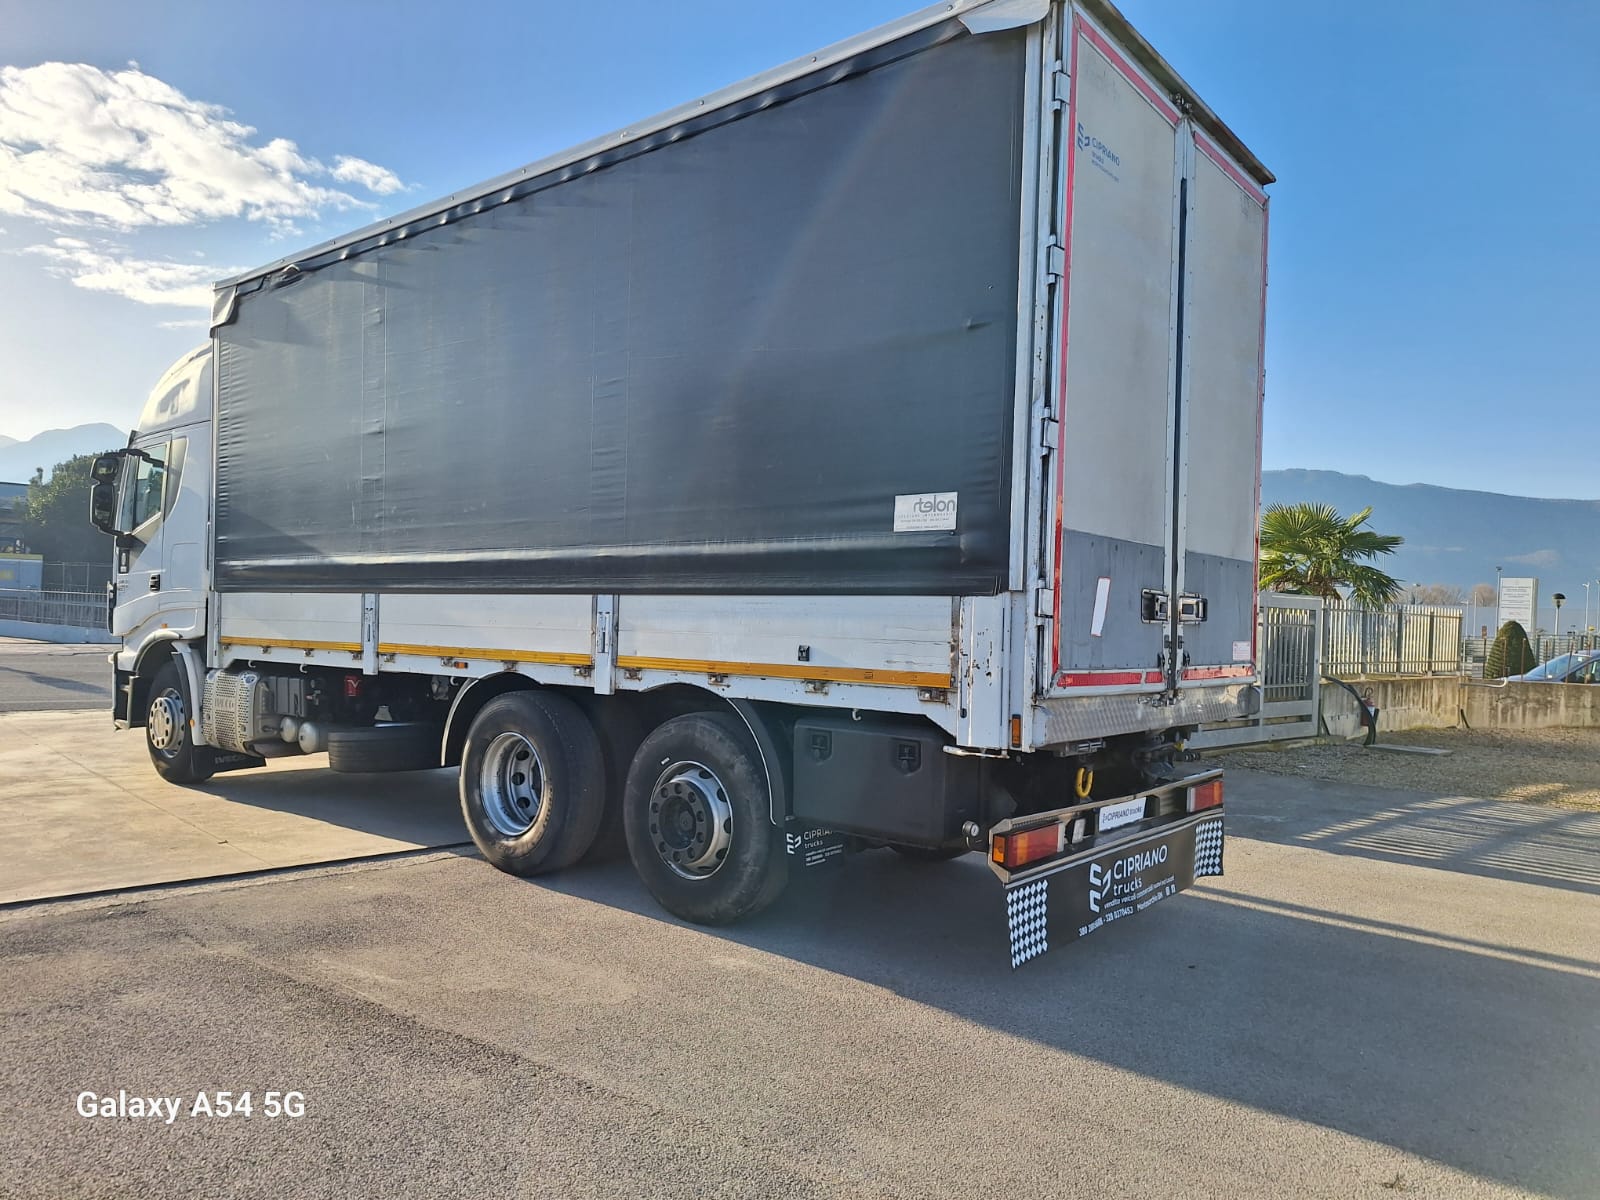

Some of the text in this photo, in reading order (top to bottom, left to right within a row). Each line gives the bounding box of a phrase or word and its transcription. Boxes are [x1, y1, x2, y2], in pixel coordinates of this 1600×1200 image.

[1091, 137, 1120, 166] CIPRIANO
[804, 840, 823, 849] trucks
[1113, 845, 1168, 879] CIPRIANO
[1113, 877, 1142, 896] trucks
